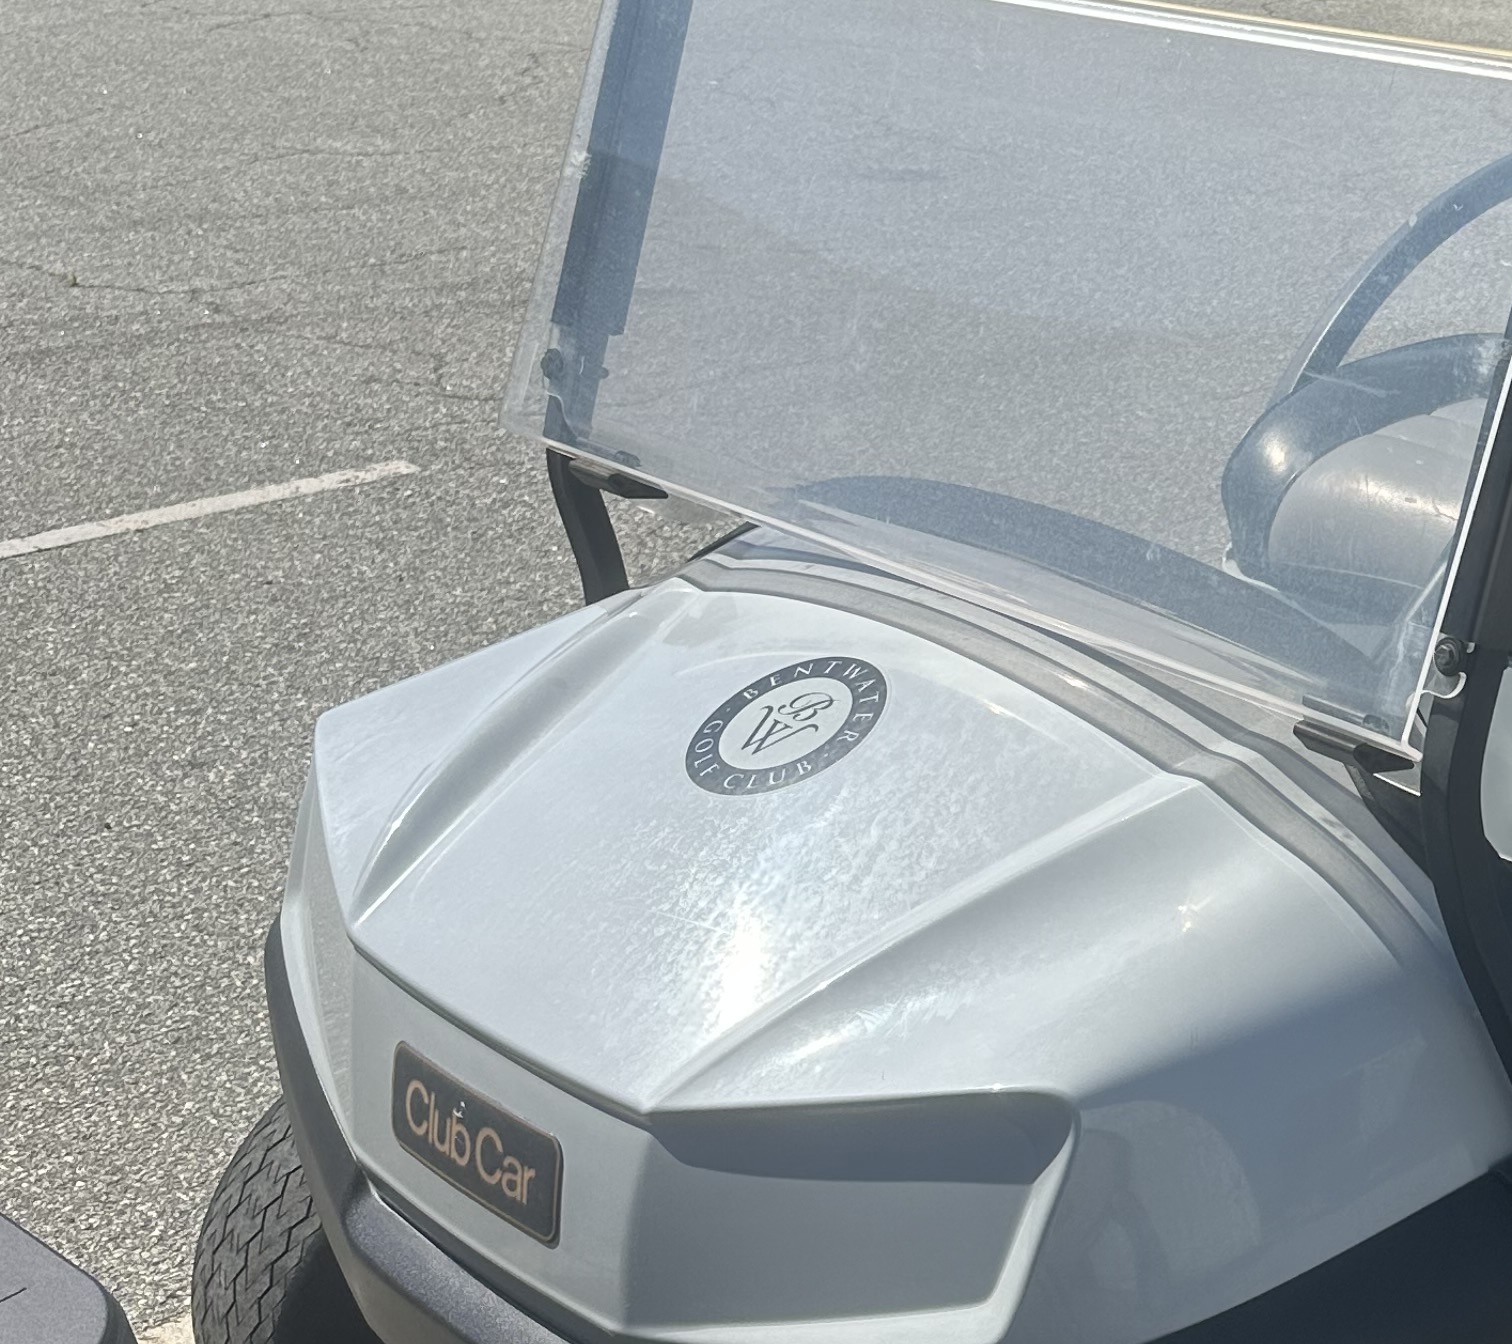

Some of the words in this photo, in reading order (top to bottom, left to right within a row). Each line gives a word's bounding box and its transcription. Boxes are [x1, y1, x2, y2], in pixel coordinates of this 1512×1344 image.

[743, 660, 880, 742] BENTWATER
[694, 719, 724, 777] GOLF
[723, 760, 812, 790] CLUB
[406, 1079, 471, 1167] Club
[475, 1127, 536, 1205] Car
